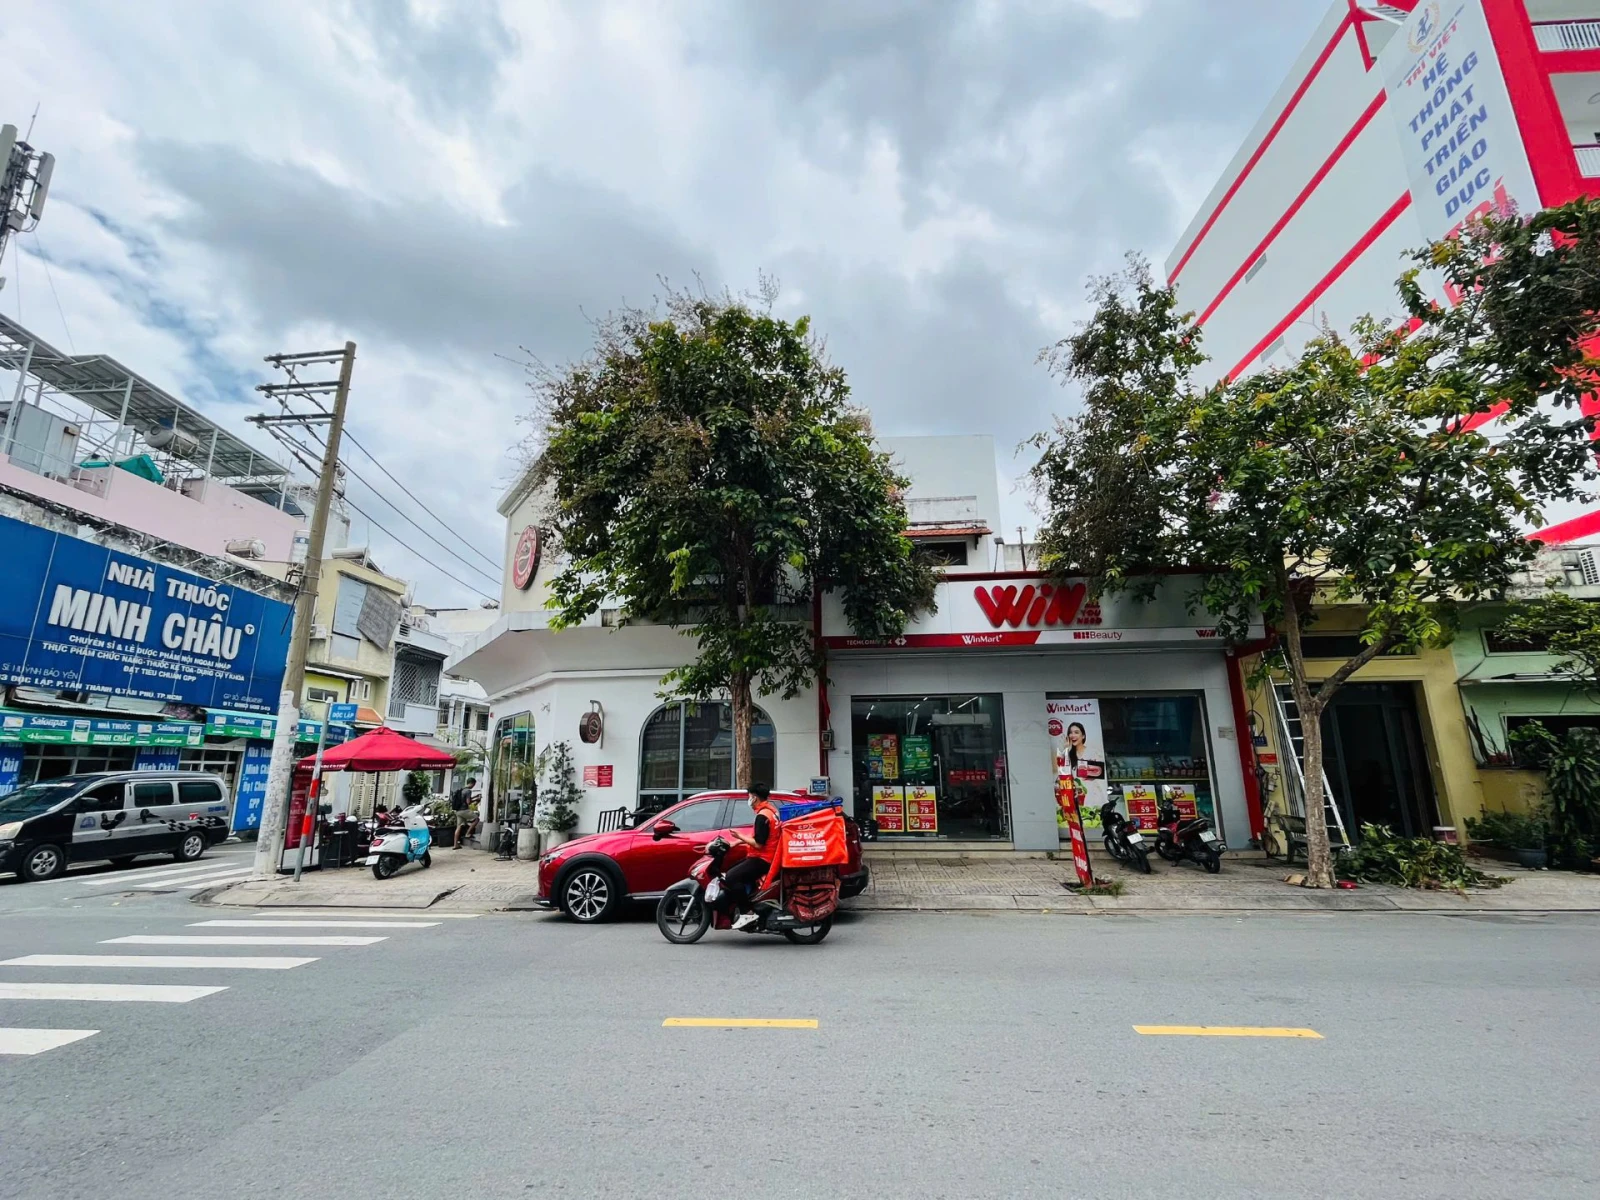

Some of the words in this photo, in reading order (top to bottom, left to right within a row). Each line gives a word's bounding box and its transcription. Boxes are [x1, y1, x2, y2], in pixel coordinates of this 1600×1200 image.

[1409, 51, 1478, 133] THỐNG
[1422, 52, 1448, 92] HỆ
[1421, 84, 1473, 151] PHÁT
[1424, 105, 1487, 176] TRIỂN
[1436, 138, 1487, 196] GIÁO
[1445, 168, 1490, 218] DỤC
[107, 561, 154, 592] NHÀ
[166, 577, 229, 611] THUỐC
[48, 584, 152, 642] MINH
[162, 612, 242, 660] CHÂU
[42, 642, 68, 653] THỰC
[70, 647, 95, 657] PHẨM
[97, 651, 120, 660] CHỨC
[69, 635, 104, 648] CHUYÊN
[137, 648, 158, 658] DƯỢC
[159, 650, 180, 660] PHẨM
[43, 668, 60, 678] BẢO
